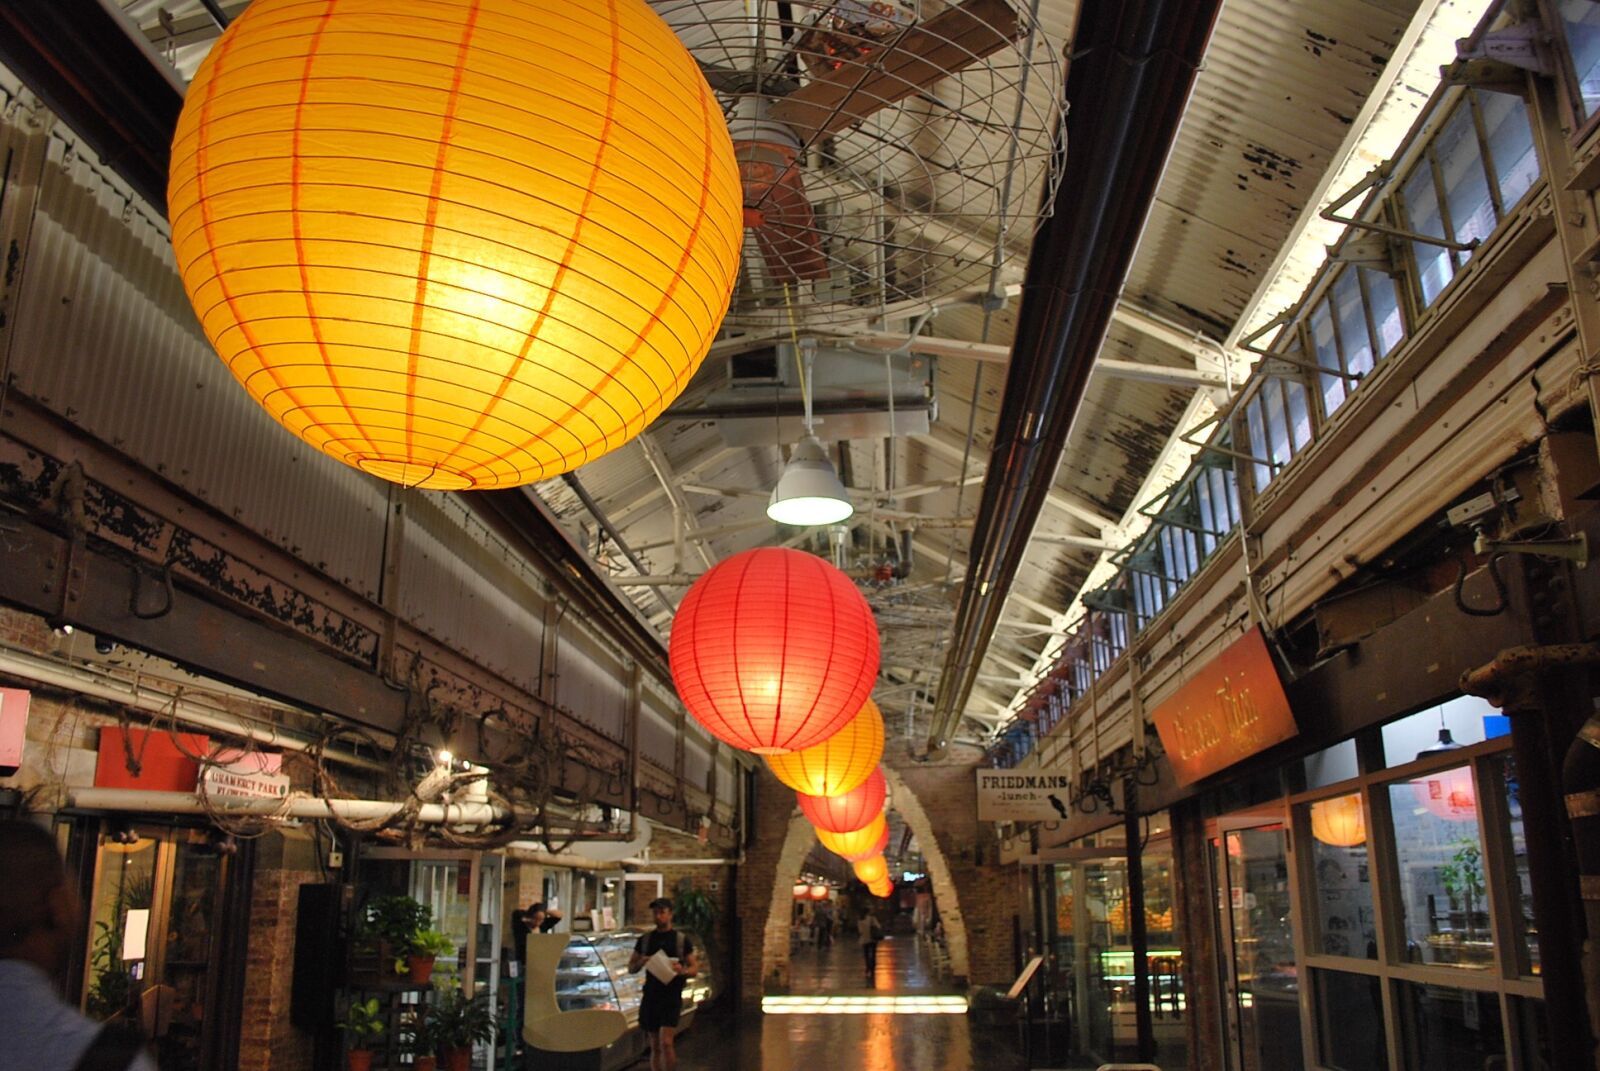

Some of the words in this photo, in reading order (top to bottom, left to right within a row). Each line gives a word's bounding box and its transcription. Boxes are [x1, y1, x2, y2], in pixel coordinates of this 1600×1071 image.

[212, 772, 256, 791] GRAMERCY
[258, 782, 278, 795] PARK
[982, 775, 1067, 789] FRIEDMANS
